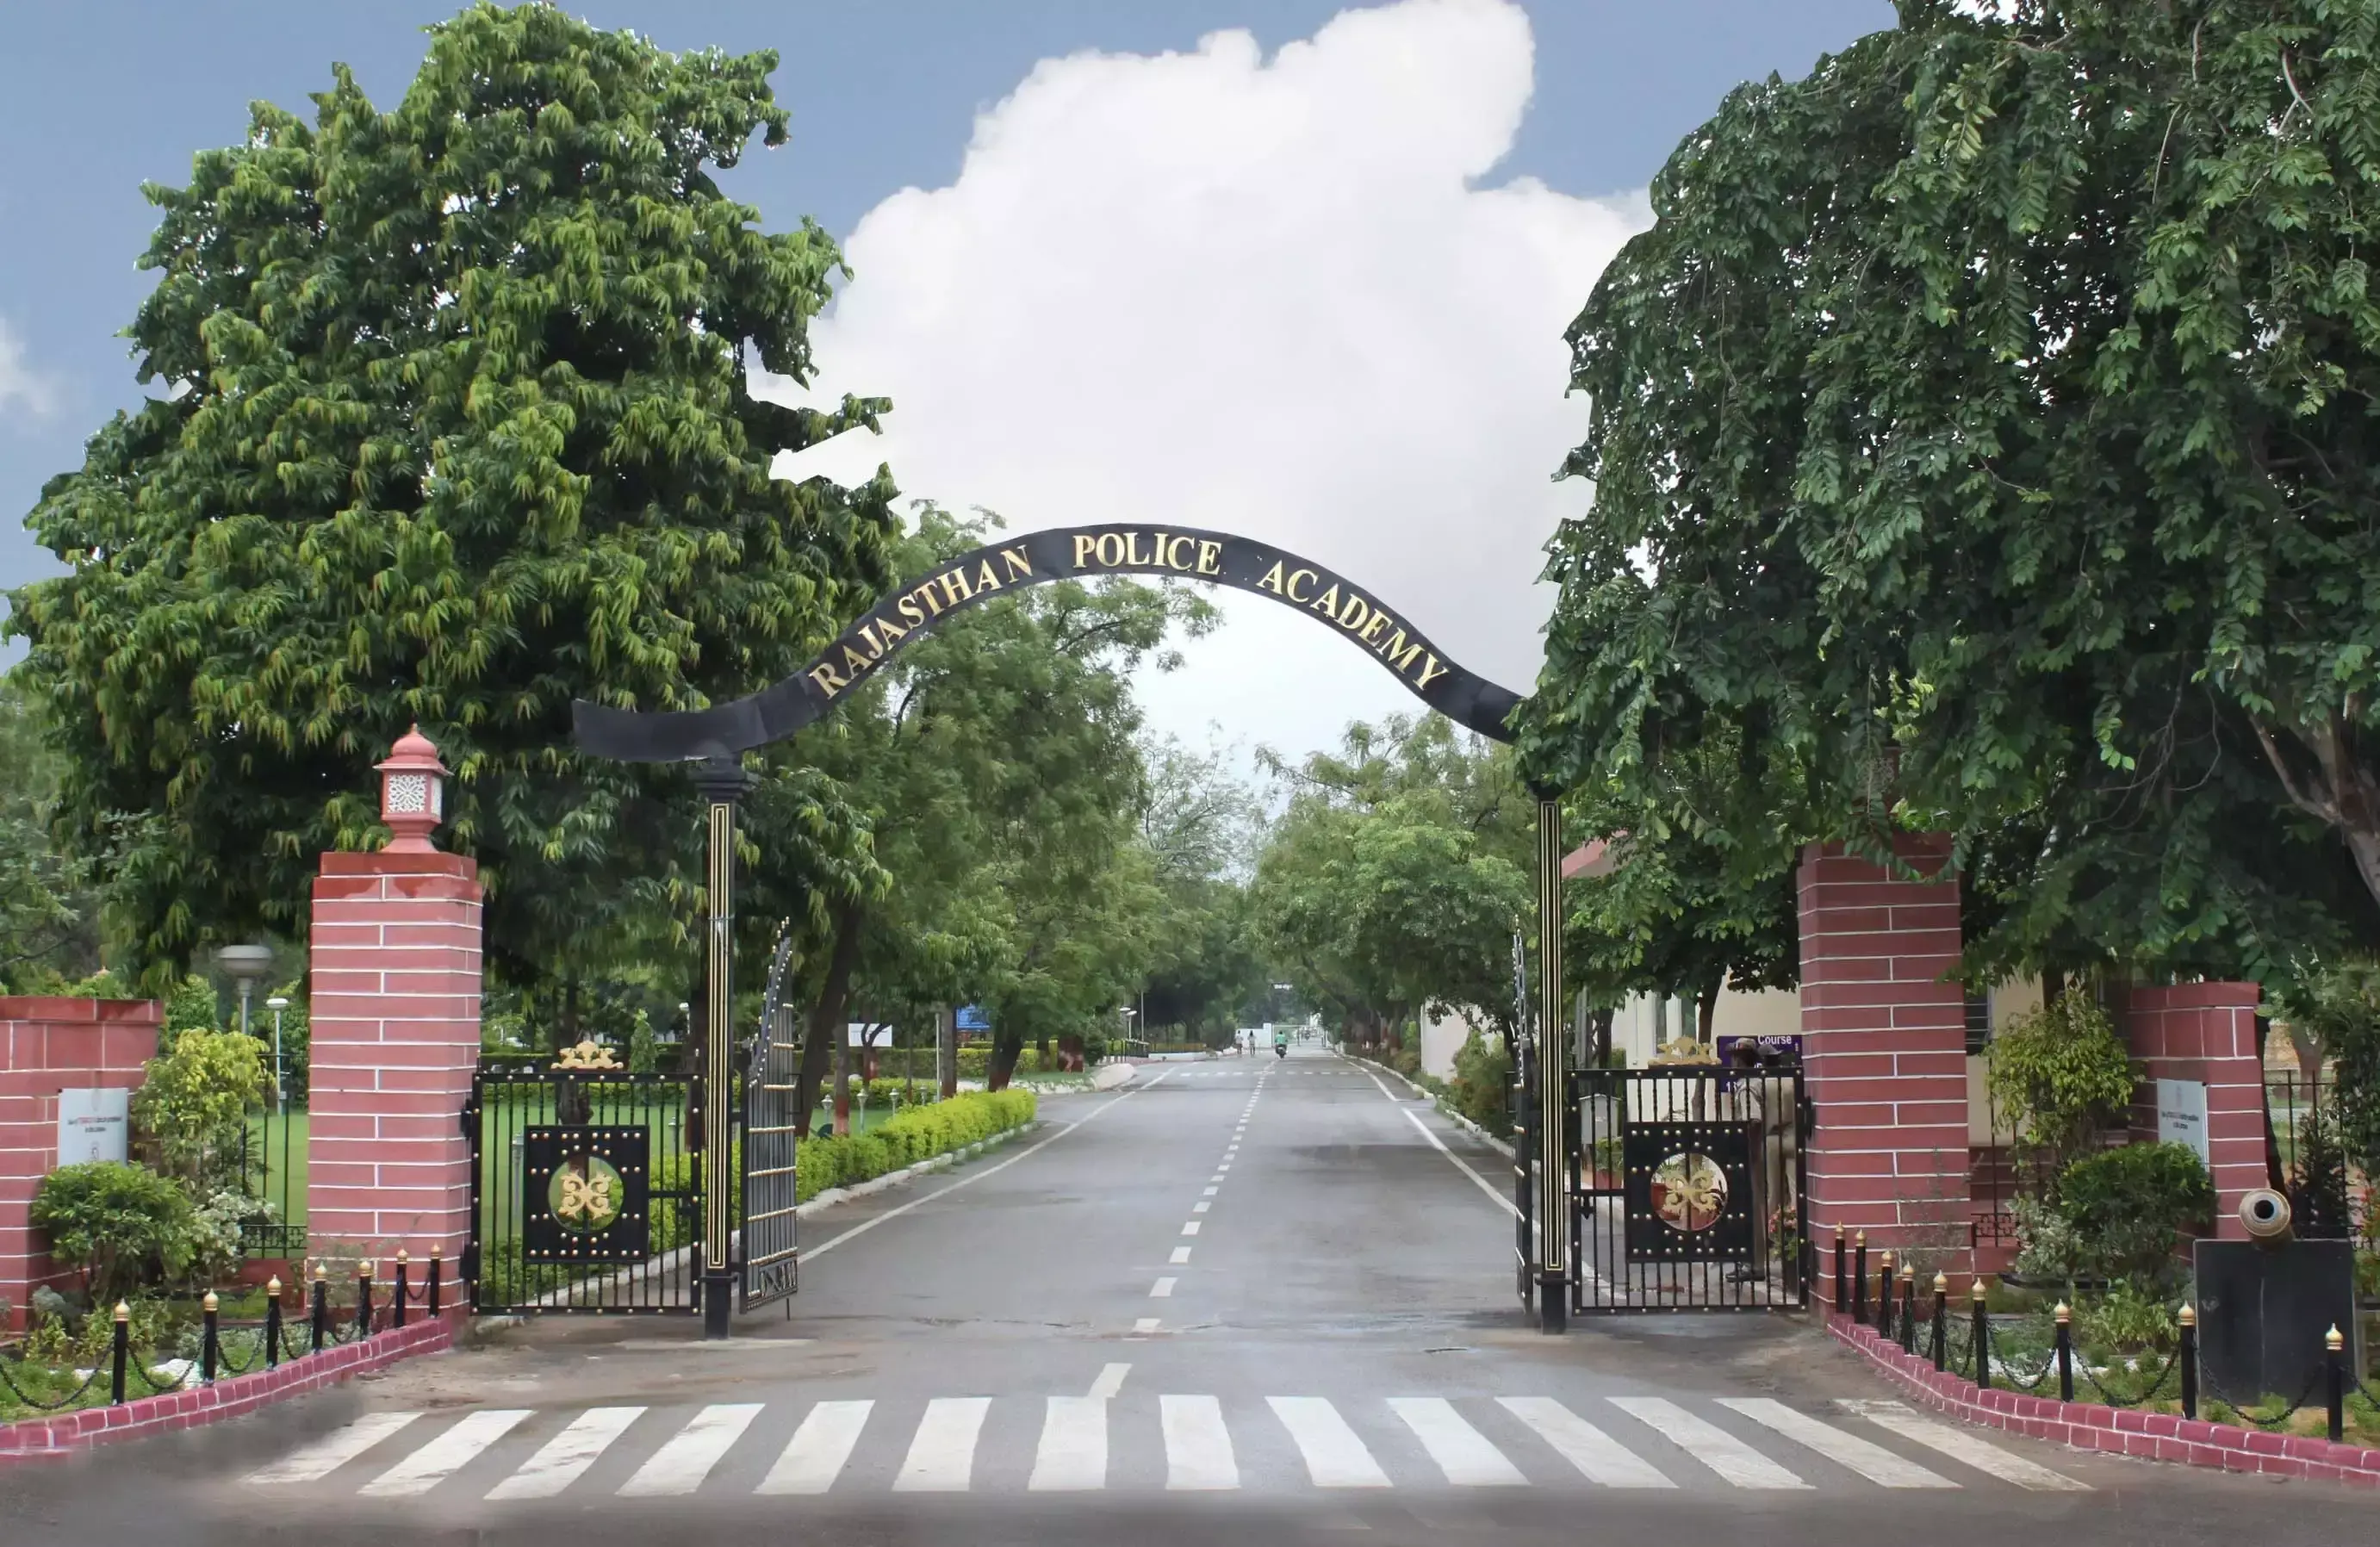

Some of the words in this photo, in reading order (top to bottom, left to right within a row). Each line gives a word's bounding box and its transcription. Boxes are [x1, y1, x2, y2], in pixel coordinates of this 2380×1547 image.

[808, 544, 1034, 700] RAJASTHAN
[1072, 531, 1222, 576] POLICE
[1255, 559, 1451, 691] ACADEMY
[1757, 1034, 1793, 1045] Course
